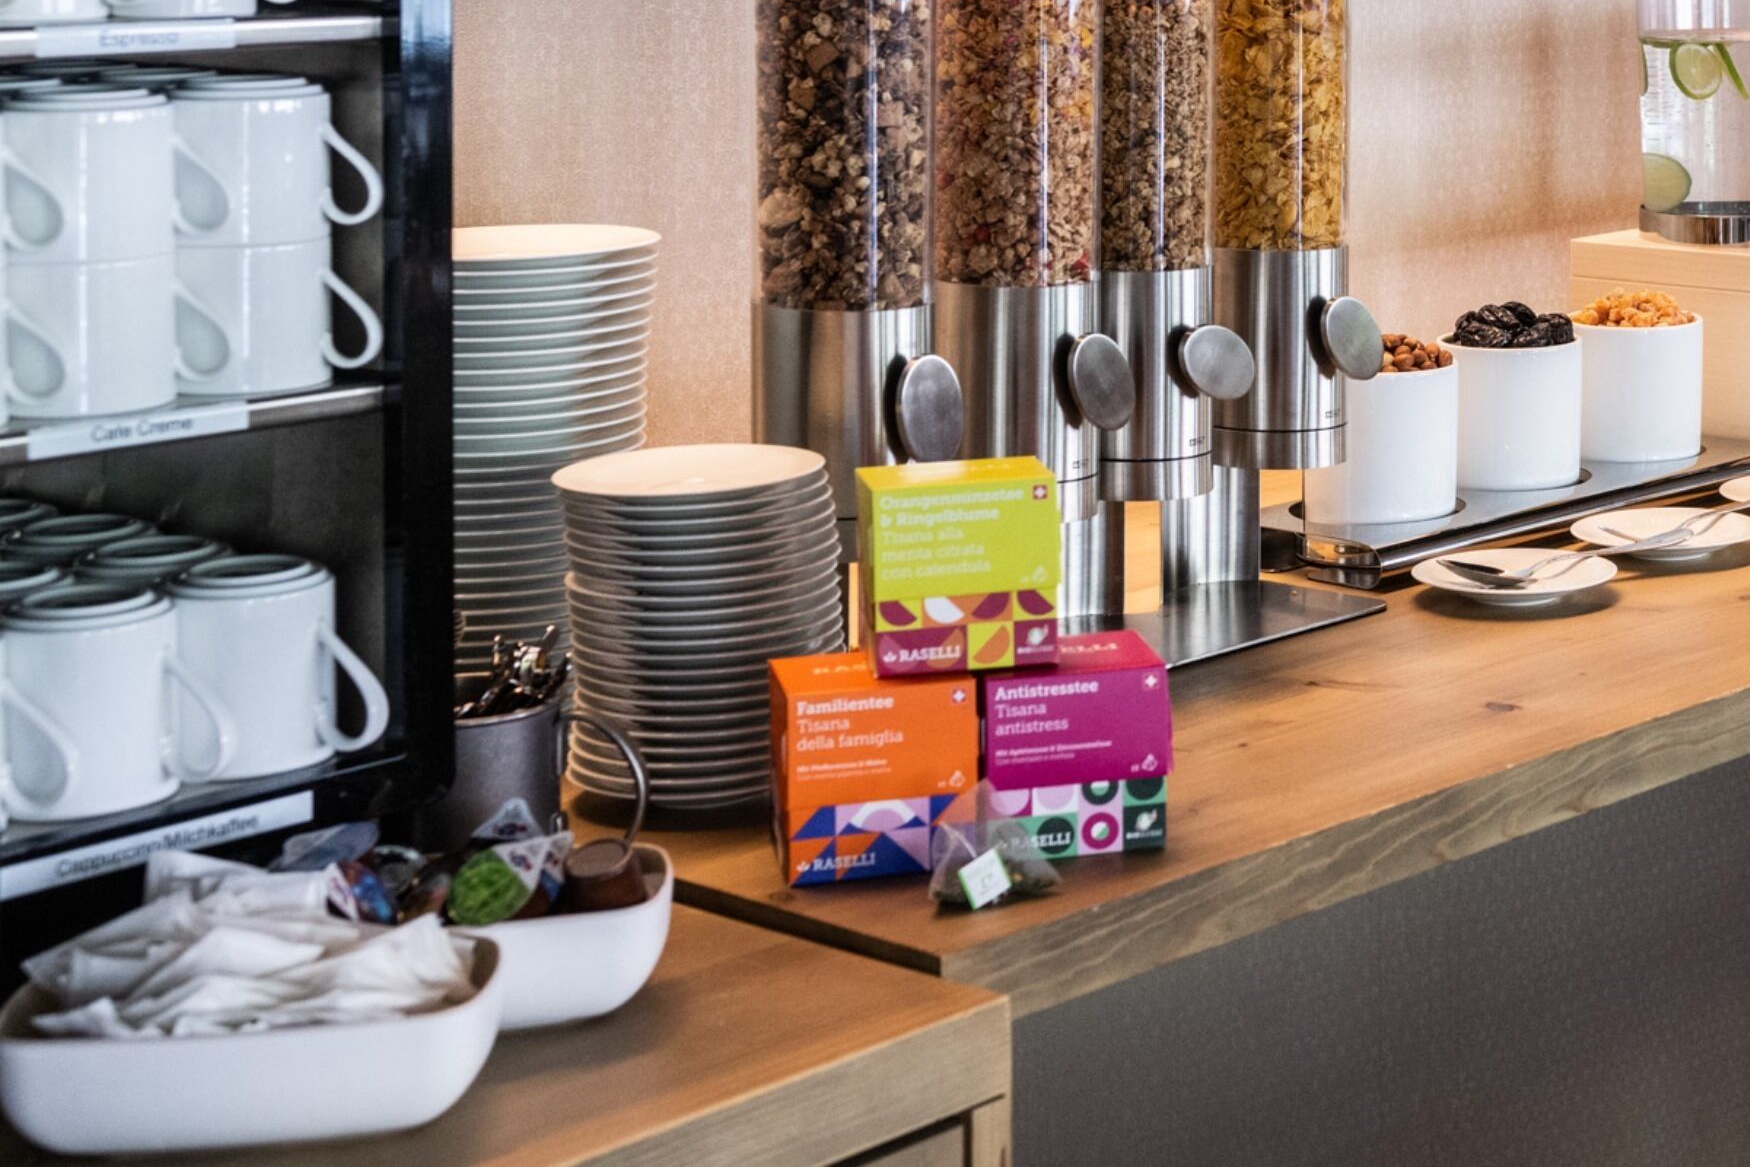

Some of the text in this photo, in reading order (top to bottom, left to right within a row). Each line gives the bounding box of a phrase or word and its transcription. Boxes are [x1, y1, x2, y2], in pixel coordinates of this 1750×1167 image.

[880, 488, 1024, 510] Orangenminzetee
[880, 507, 1000, 527] & Ringelblume
[882, 526, 964, 545] Tisana alla
[881, 543, 984, 562] menta citrata
[882, 560, 992, 580] con calendula
[899, 645, 961, 662] RASELLI
[994, 681, 1099, 701] Antistresstee
[796, 696, 894, 716] Familientee
[994, 703, 1047, 719] Tisana
[796, 718, 850, 734] Tisana
[994, 719, 1070, 737] antistress
[796, 730, 904, 752] della famiglia
[813, 852, 876, 871] RASELLI
